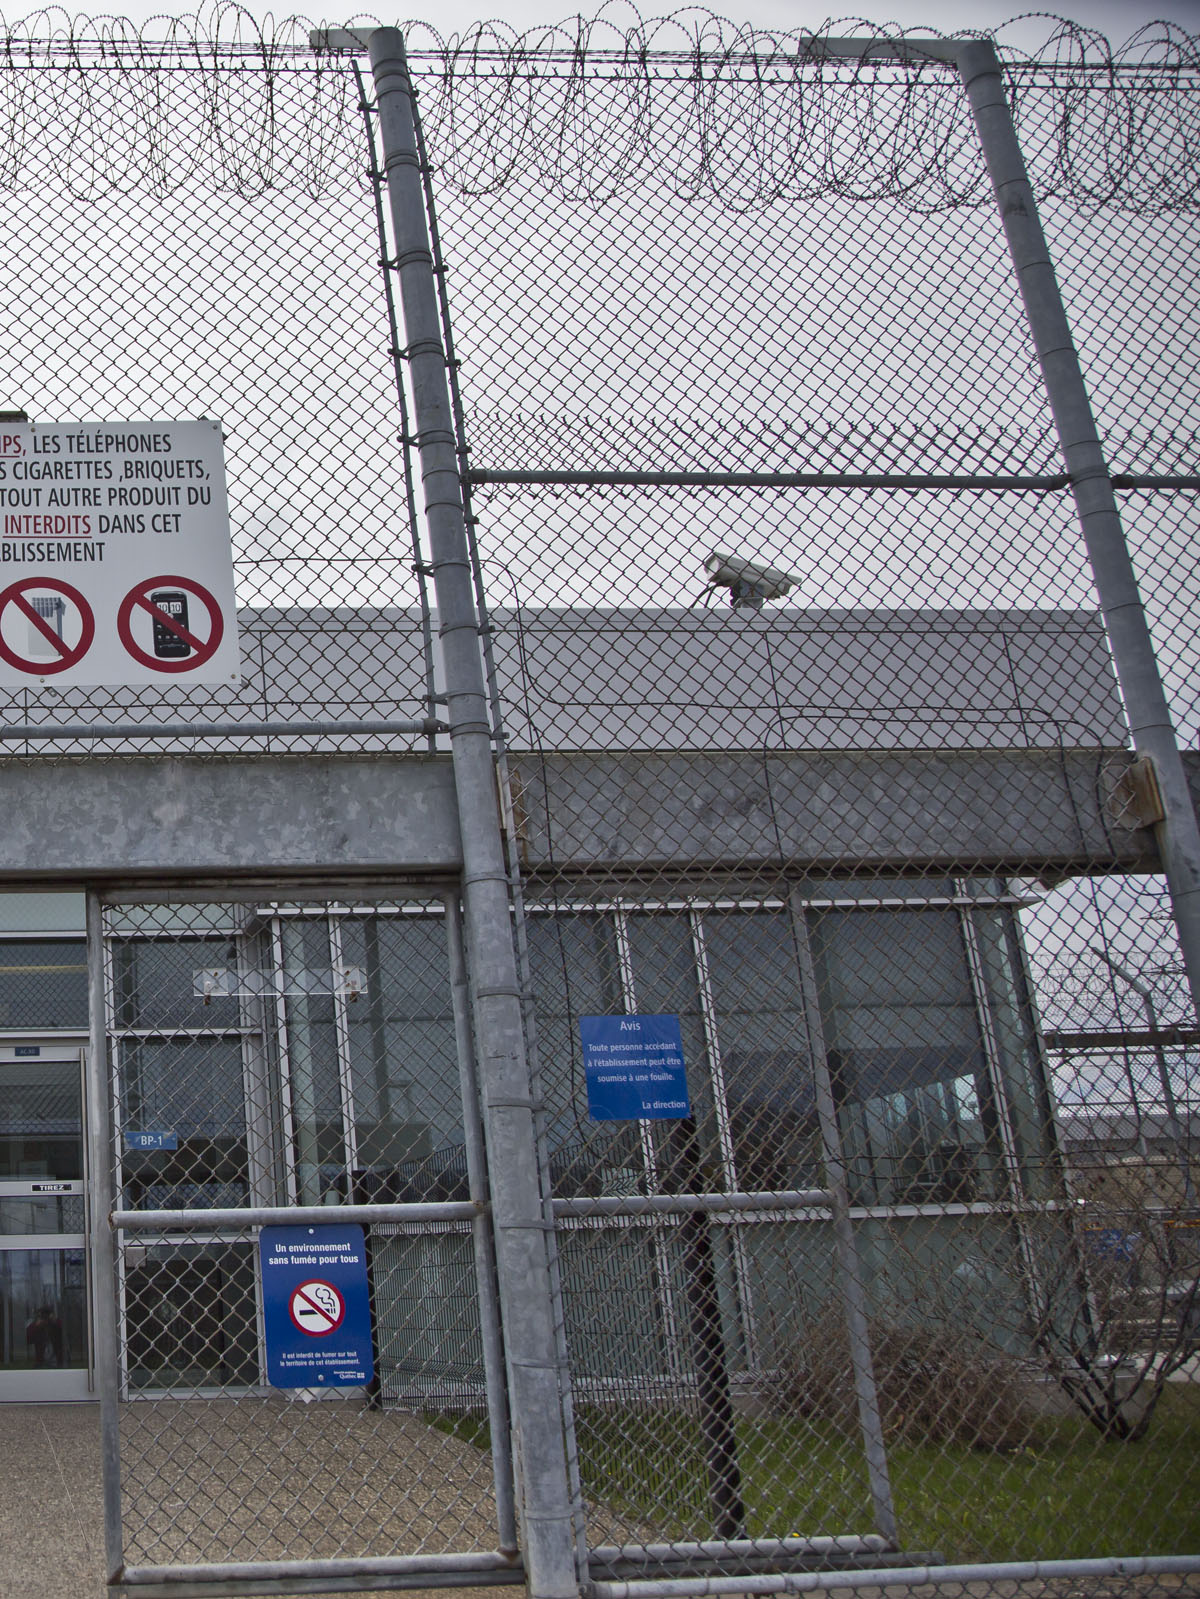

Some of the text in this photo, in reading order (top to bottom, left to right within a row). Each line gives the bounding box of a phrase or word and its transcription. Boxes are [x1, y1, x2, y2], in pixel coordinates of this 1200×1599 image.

[33, 435, 61, 454] LES
[66, 430, 172, 453] TÉLÉPHONES
[12, 460, 113, 480] CIGARETTES
[47, 487, 102, 507] AUTRE
[108, 486, 181, 506] PRODUIT
[187, 486, 212, 506] DU
[4, 515, 92, 535] INTERDITS
[98, 514, 146, 534] DANS
[151, 513, 182, 533] CET
[620, 1021, 641, 1031] Avis
[588, 1041, 677, 1054] Toute personne accédant
[649, 1058, 665, 1067] peut
[666, 1056, 681, 1065] être
[597, 1074, 628, 1083] soumise
[642, 1100, 686, 1110] La direction
[141, 1136, 162, 1145] BP-1
[275, 1242, 351, 1253] Un environnement
[269, 1255, 359, 1265] sans fumée pour tous
